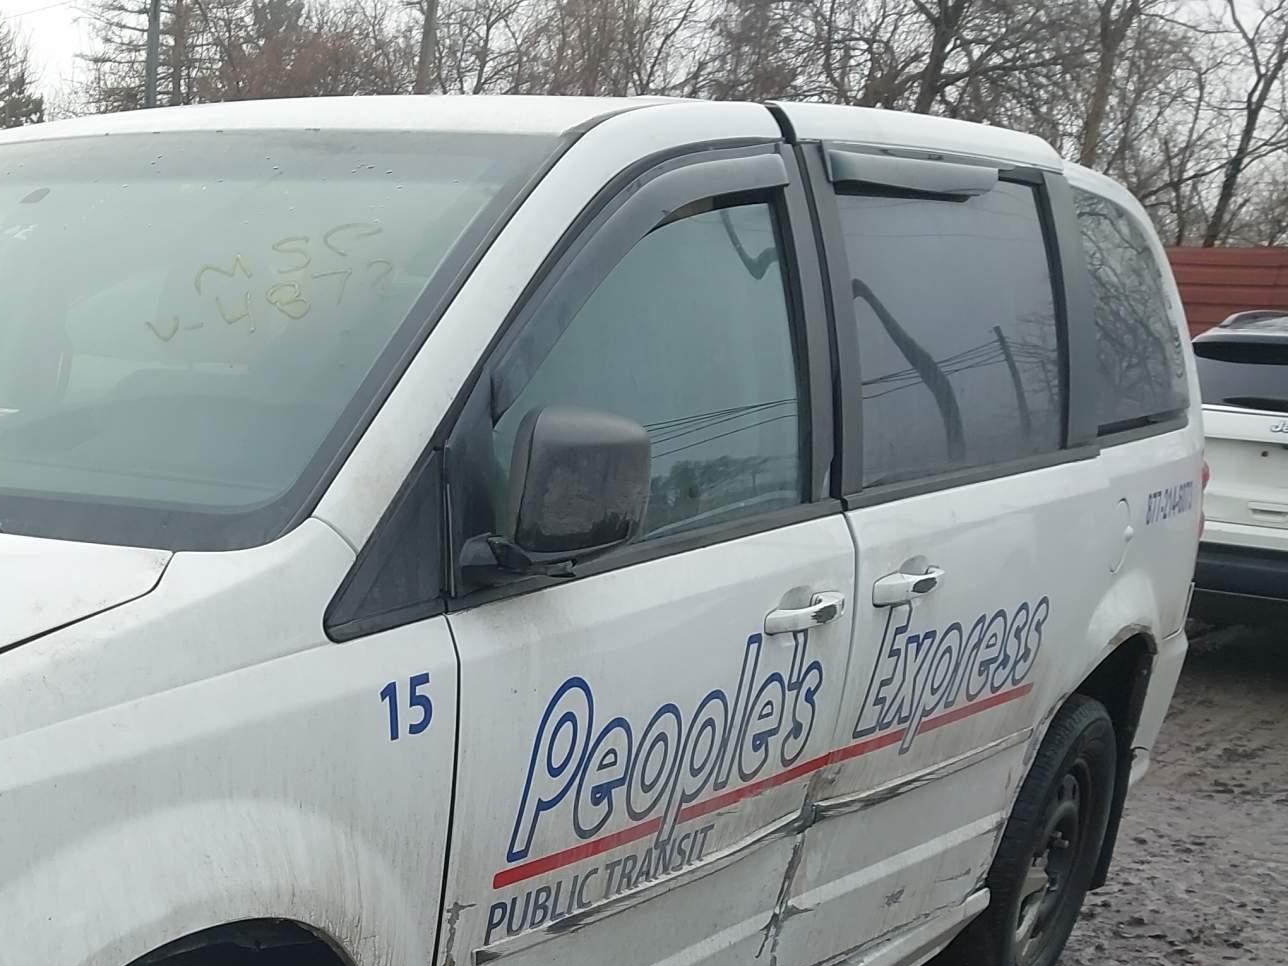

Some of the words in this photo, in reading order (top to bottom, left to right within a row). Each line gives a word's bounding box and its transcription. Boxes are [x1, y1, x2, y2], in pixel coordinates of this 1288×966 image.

[380, 672, 434, 741] 15
[506, 632, 824, 863] People's
[852, 595, 1051, 755] Express
[484, 867, 599, 946] PUBLIC
[602, 823, 716, 899] TRANSIT
